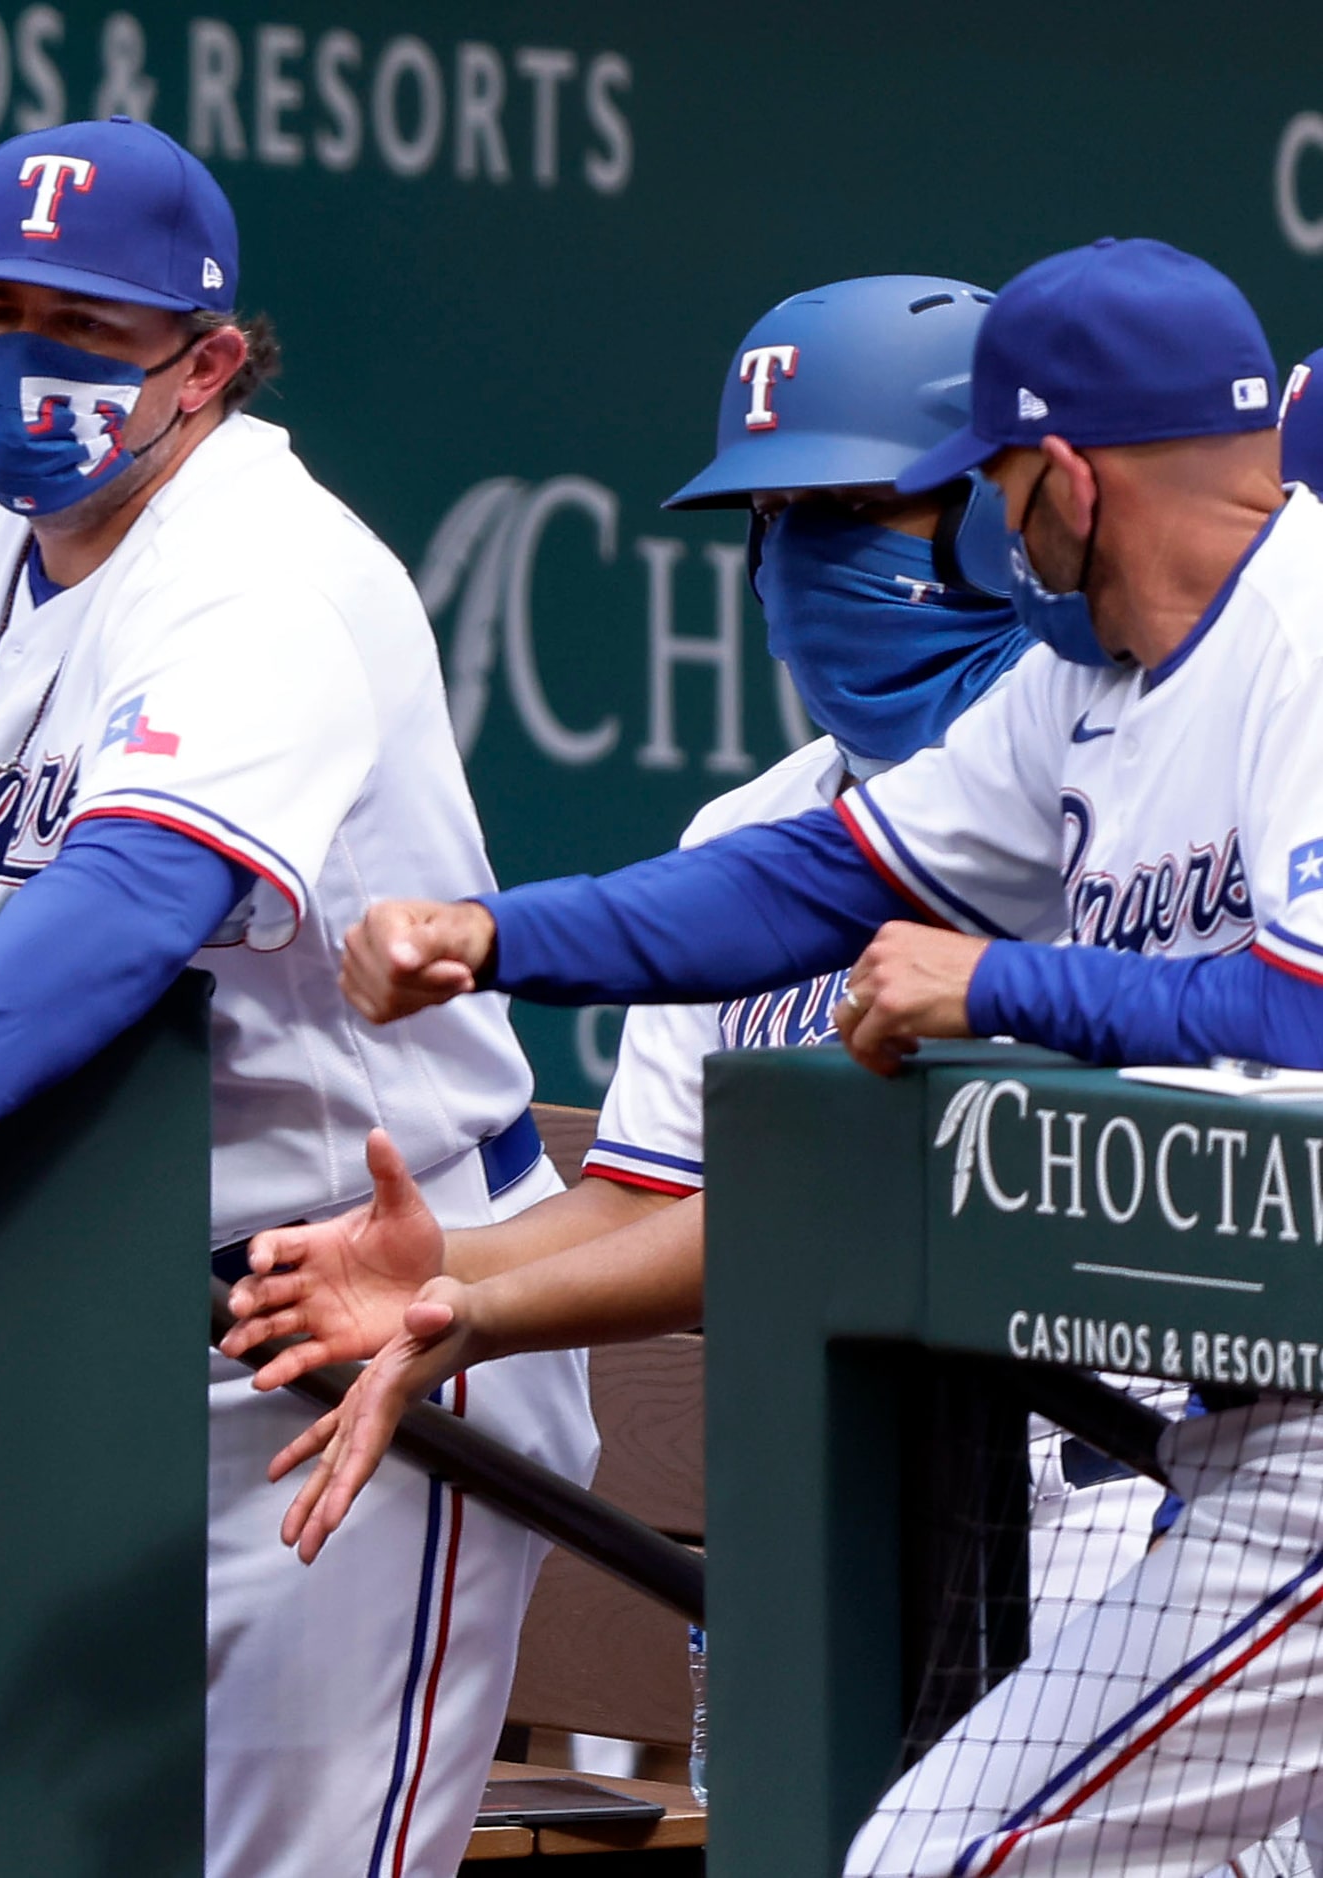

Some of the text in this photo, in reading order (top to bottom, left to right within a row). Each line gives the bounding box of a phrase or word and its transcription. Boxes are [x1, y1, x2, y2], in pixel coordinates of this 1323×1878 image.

[96, 12, 158, 122] &
[187, 17, 633, 193] RESORTS
[18, 154, 97, 240] T
[739, 344, 800, 432] T
[1060, 787, 1256, 957] ngers
[1008, 1310, 1323, 1392] CASINOS & RESORT
